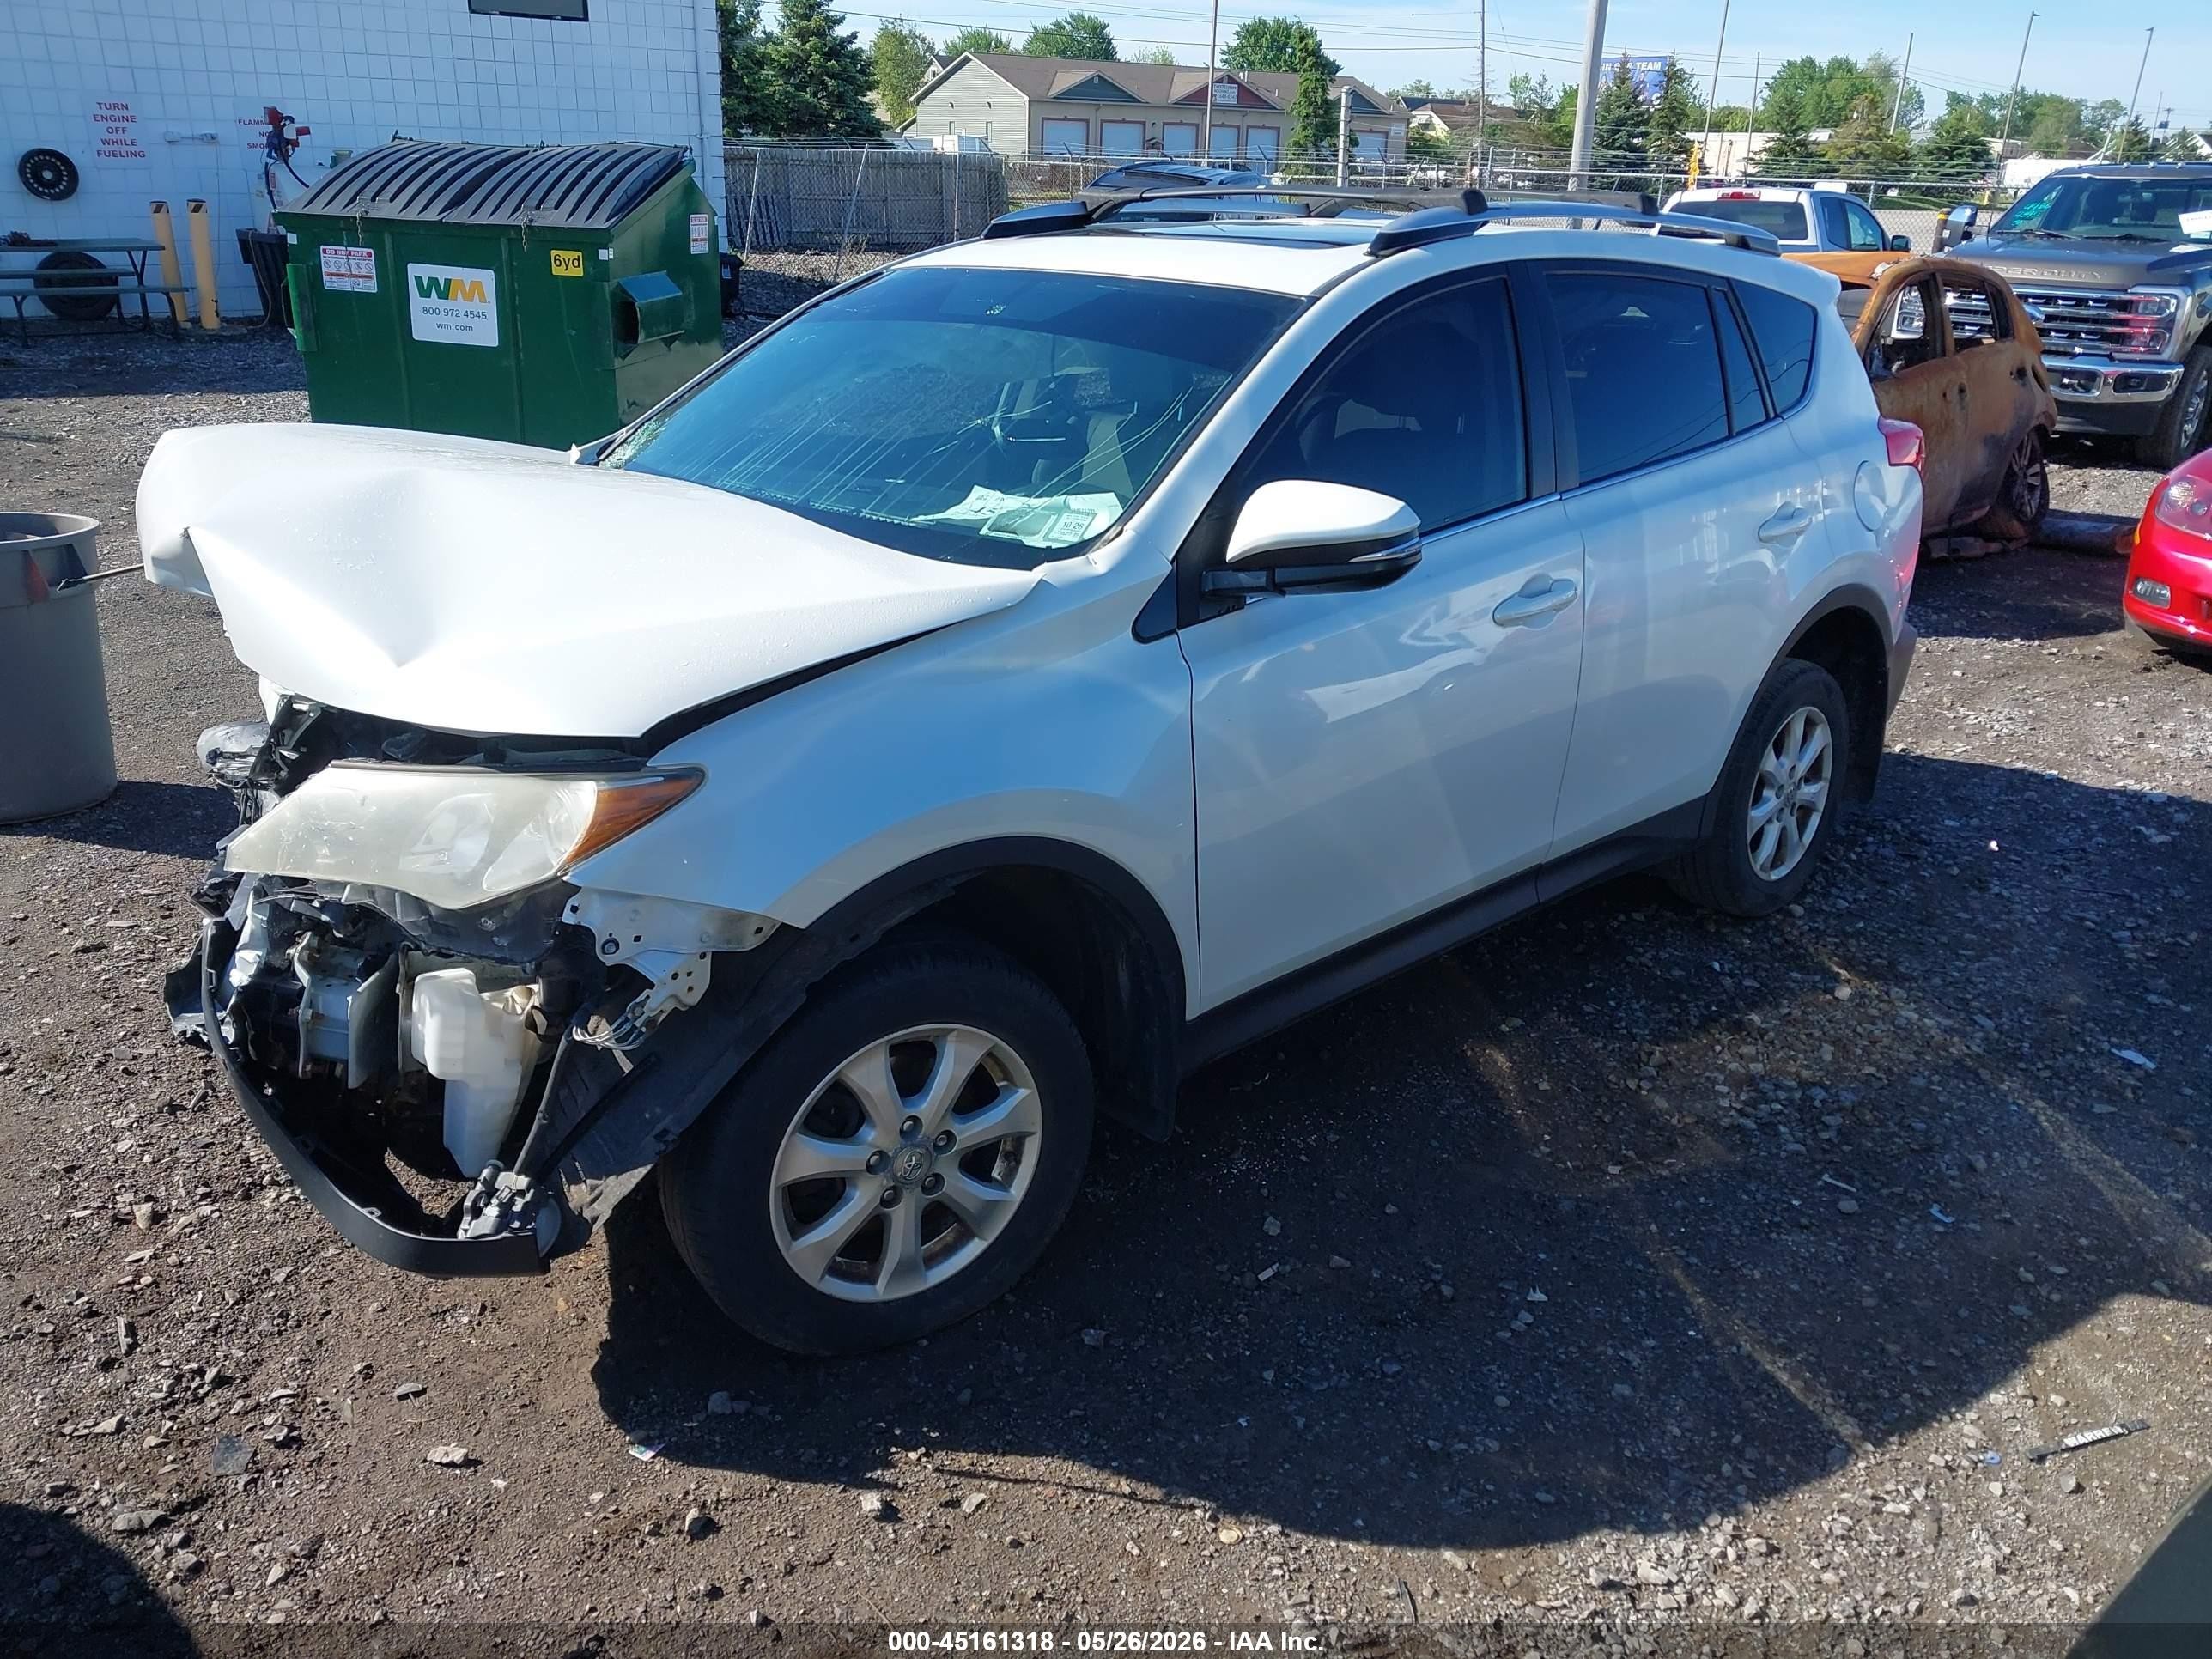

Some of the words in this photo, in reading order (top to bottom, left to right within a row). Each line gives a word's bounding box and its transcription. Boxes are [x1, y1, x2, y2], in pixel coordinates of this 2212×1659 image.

[1636, 61, 1662, 70] TEAM
[96, 101, 129, 111] TURN
[93, 113, 137, 123] ENGINE
[106, 126, 128, 135] OFF
[100, 137, 137, 146] WHILE
[96, 149, 146, 158] FUELING
[554, 253, 581, 271] 6yd
[2041, 268, 2102, 280] DUTY
[413, 275, 488, 304] WM
[422, 306, 441, 316] 800
[443, 308, 460, 318] 972
[463, 310, 487, 320] 4545
[436, 322, 473, 332] wm.com
